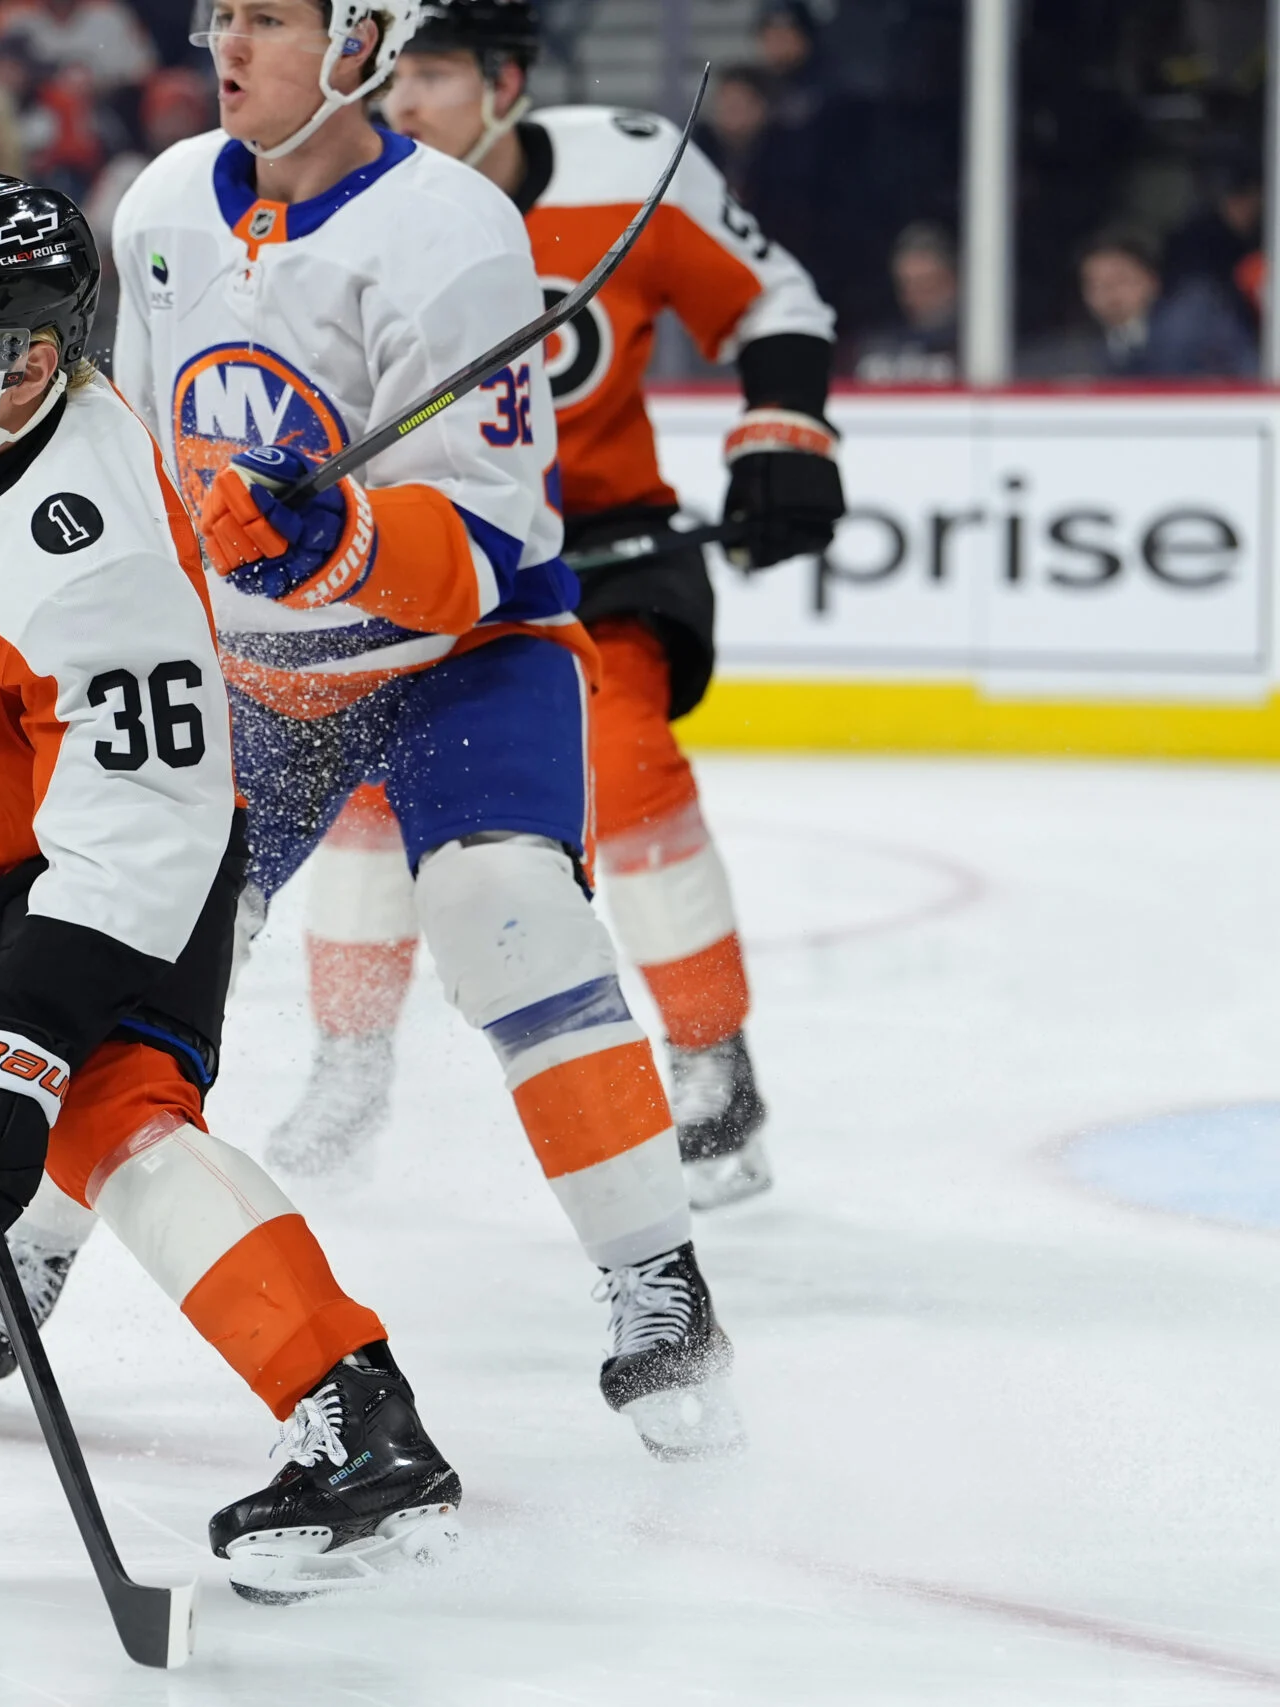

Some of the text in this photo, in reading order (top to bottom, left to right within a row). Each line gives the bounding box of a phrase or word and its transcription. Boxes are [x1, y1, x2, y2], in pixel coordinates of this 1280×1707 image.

[0, 242, 68, 267] CHEVROLET
[398, 391, 456, 435] WARRIOR
[47, 499, 90, 547] 1
[806, 474, 1242, 618] prise
[86, 659, 206, 772] 36
